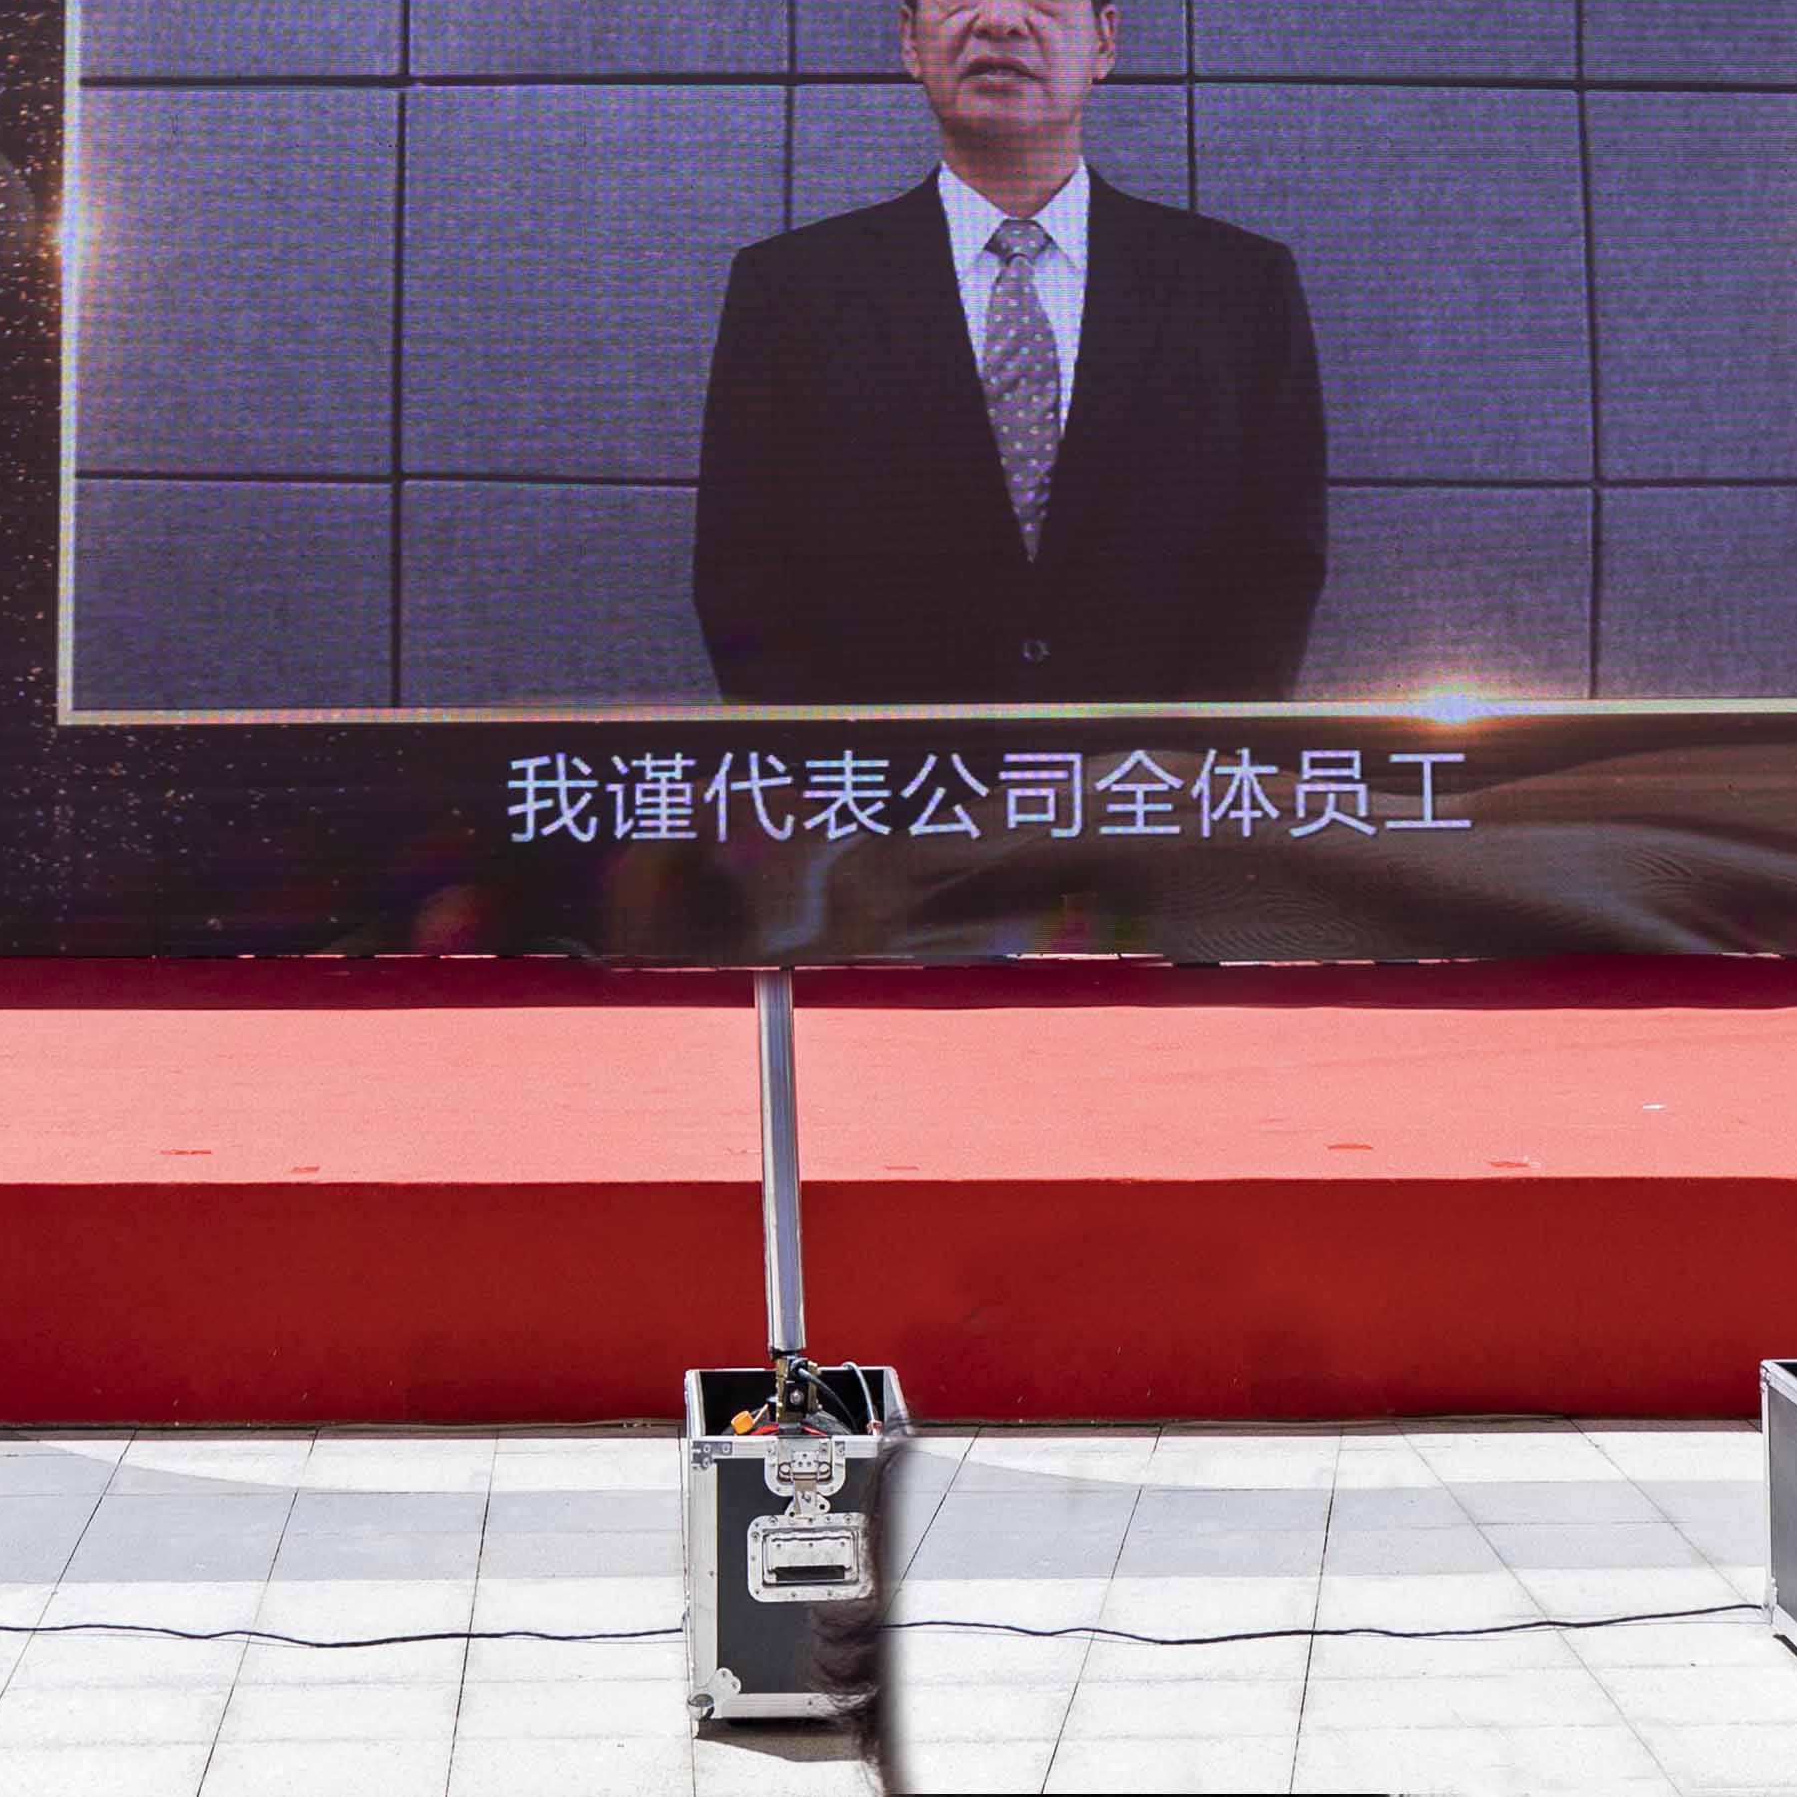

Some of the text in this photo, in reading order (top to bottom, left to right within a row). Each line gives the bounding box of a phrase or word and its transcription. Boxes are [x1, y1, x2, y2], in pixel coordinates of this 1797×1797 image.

[506, 748, 1472, 843] 我谨代表公司全体员工
